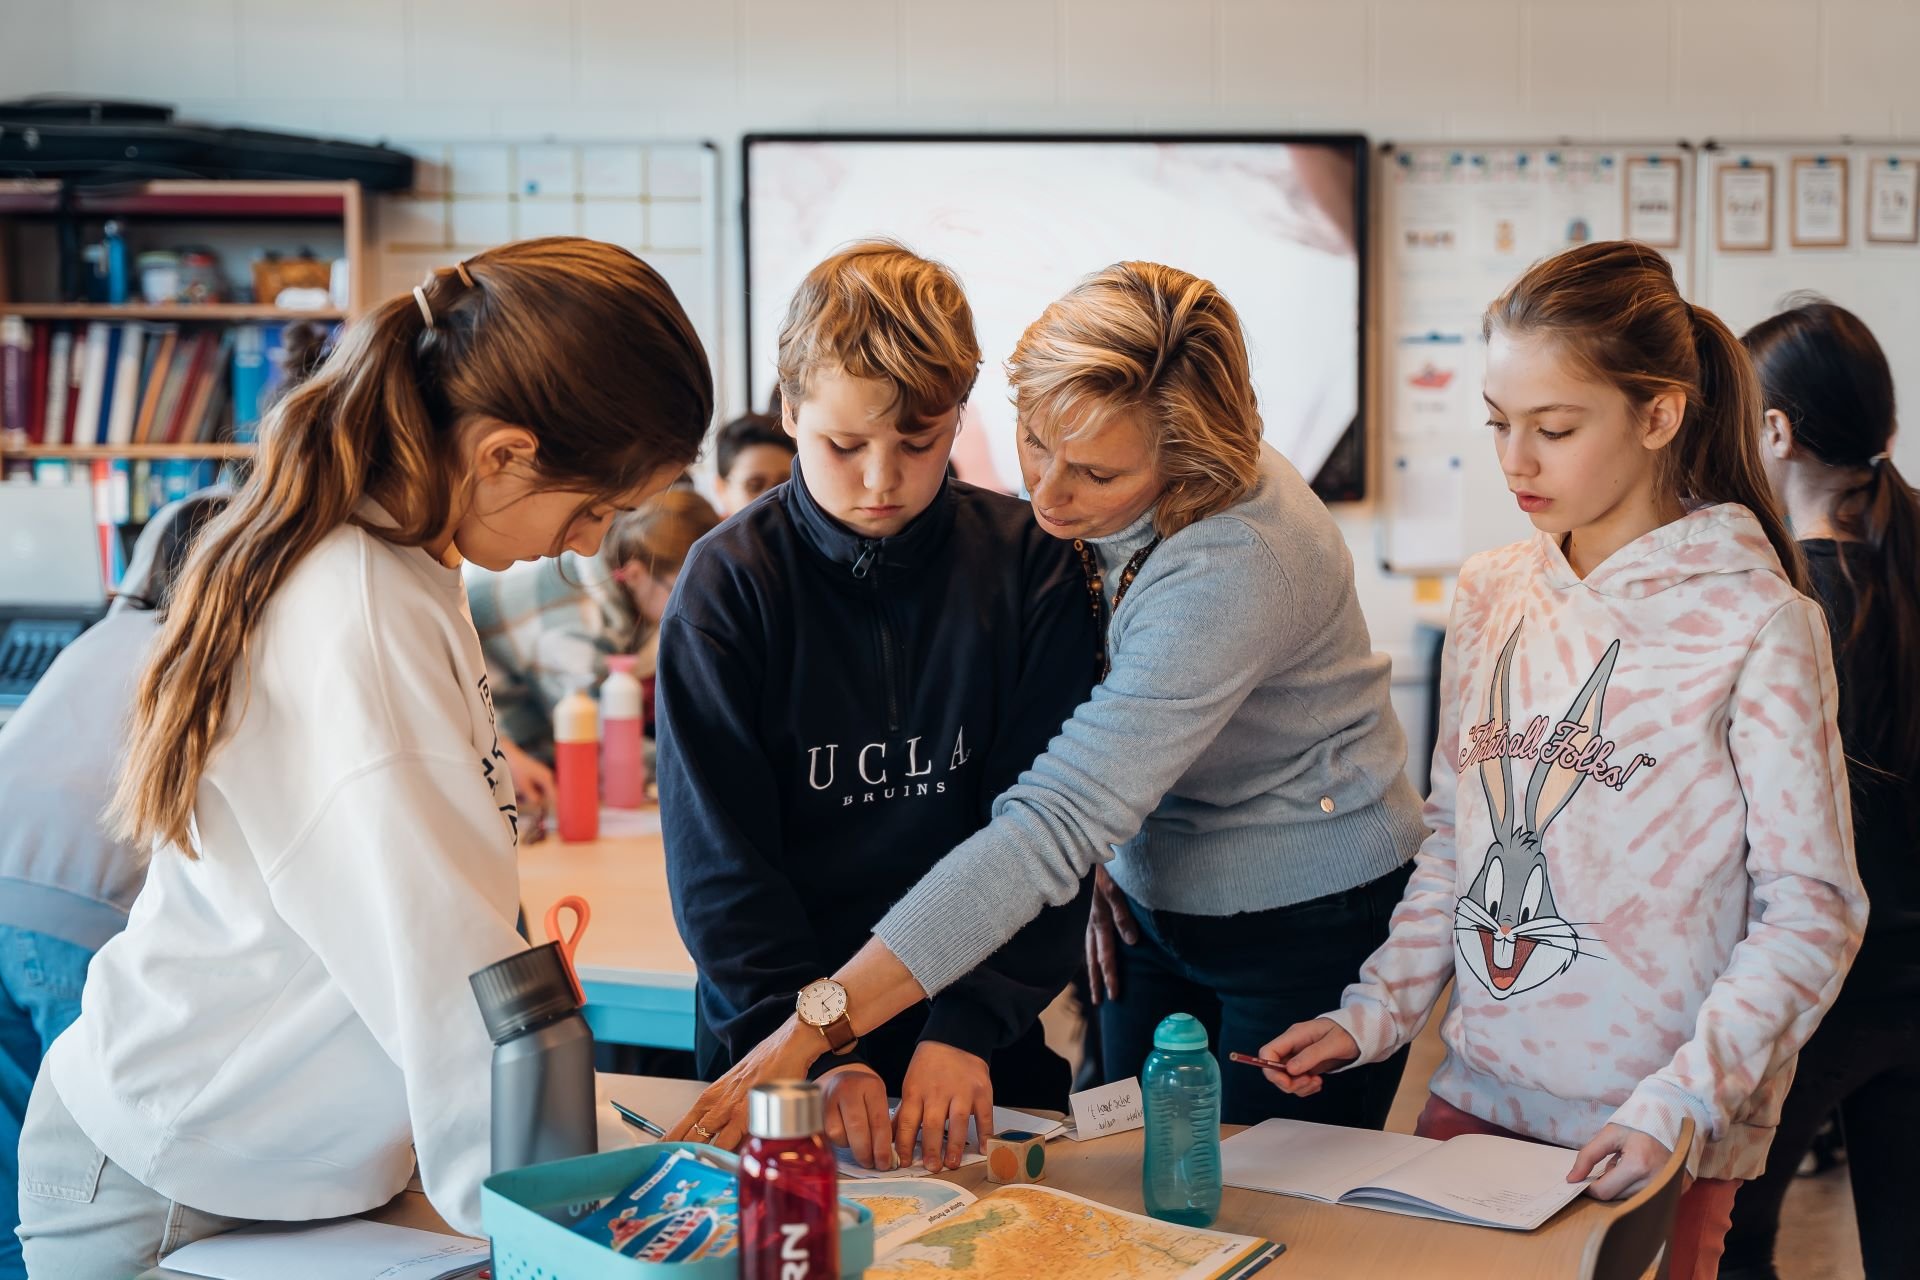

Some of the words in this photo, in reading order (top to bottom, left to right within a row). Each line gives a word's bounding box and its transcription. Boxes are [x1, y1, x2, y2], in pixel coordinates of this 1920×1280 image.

[808, 726, 967, 790] UCLA
[1508, 715, 1550, 760] all
[843, 781, 946, 806] BRUINS
